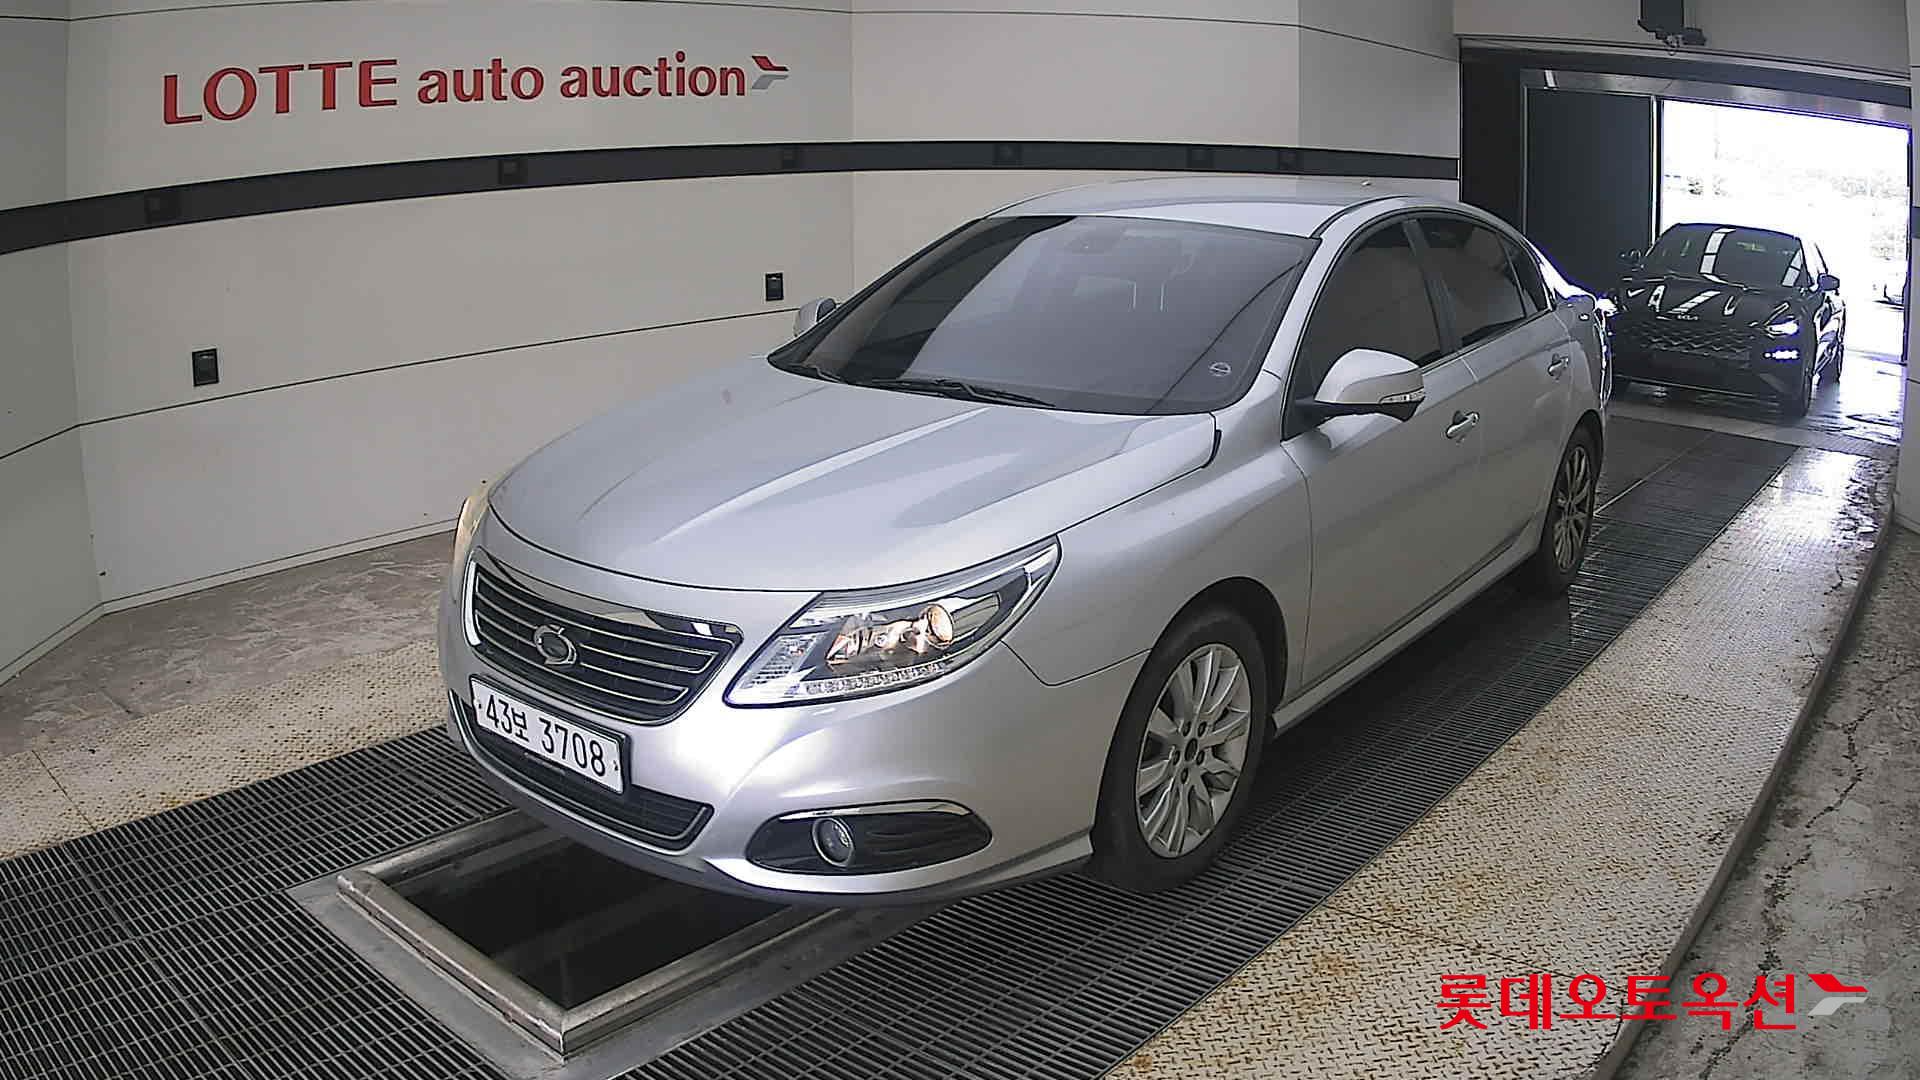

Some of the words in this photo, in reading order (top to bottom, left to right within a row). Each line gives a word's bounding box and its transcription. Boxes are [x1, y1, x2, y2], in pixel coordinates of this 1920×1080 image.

[163, 59, 398, 125] LOTTE
[417, 57, 544, 104] auto
[560, 50, 746, 98] auction
[486, 695, 529, 742] 43보
[538, 717, 606, 777] 3708
